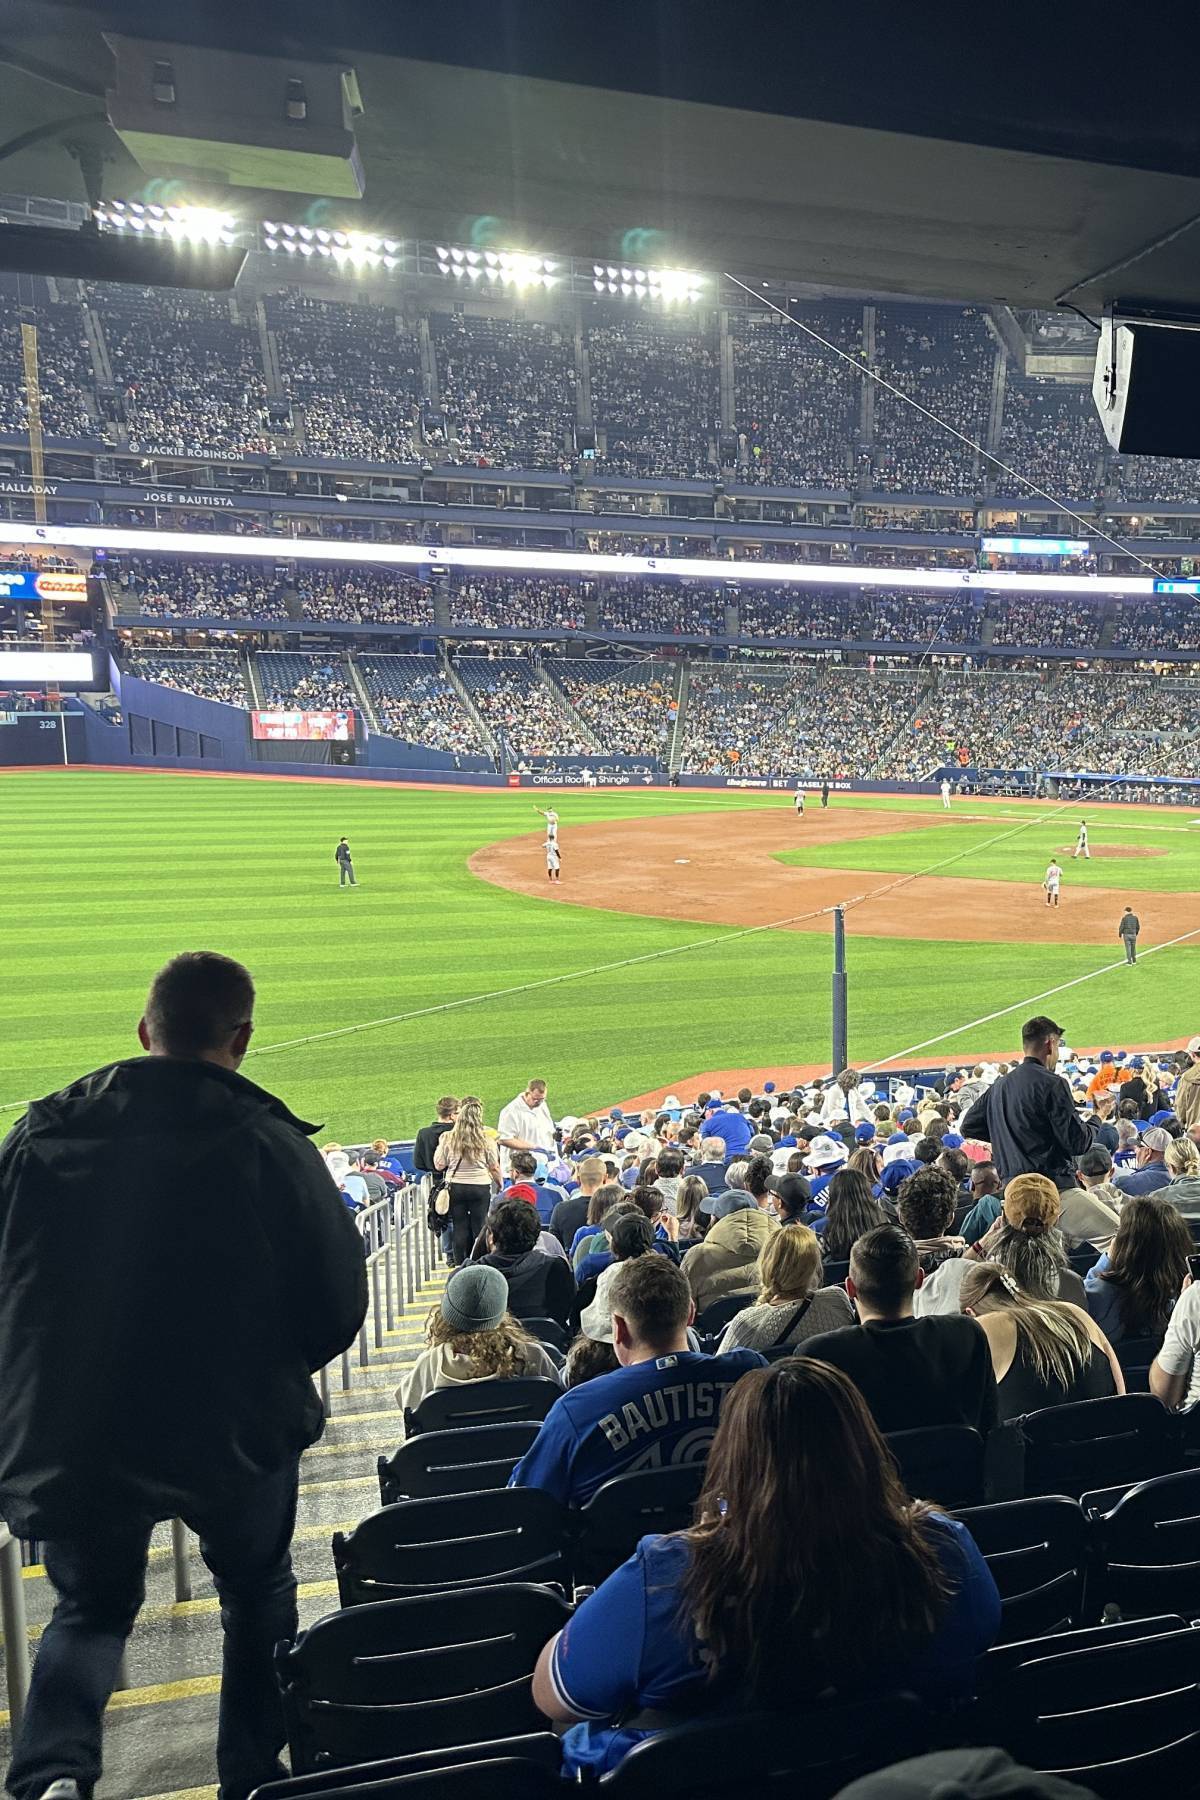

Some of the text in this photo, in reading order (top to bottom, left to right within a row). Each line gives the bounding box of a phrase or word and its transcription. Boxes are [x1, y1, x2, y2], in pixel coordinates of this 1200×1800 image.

[146, 446, 185, 457] JACKIE
[186, 448, 245, 461] ROBINSON
[0, 482, 58, 495] HALLADAY
[143, 492, 234, 507] JOSÉ BAUTISTA
[40, 721, 56, 729] 328
[533, 775, 562, 784] Official
[599, 775, 629, 785] Shingle
[835, 782, 851, 790] BOX
[598, 1382, 733, 1451] BAUTIST
